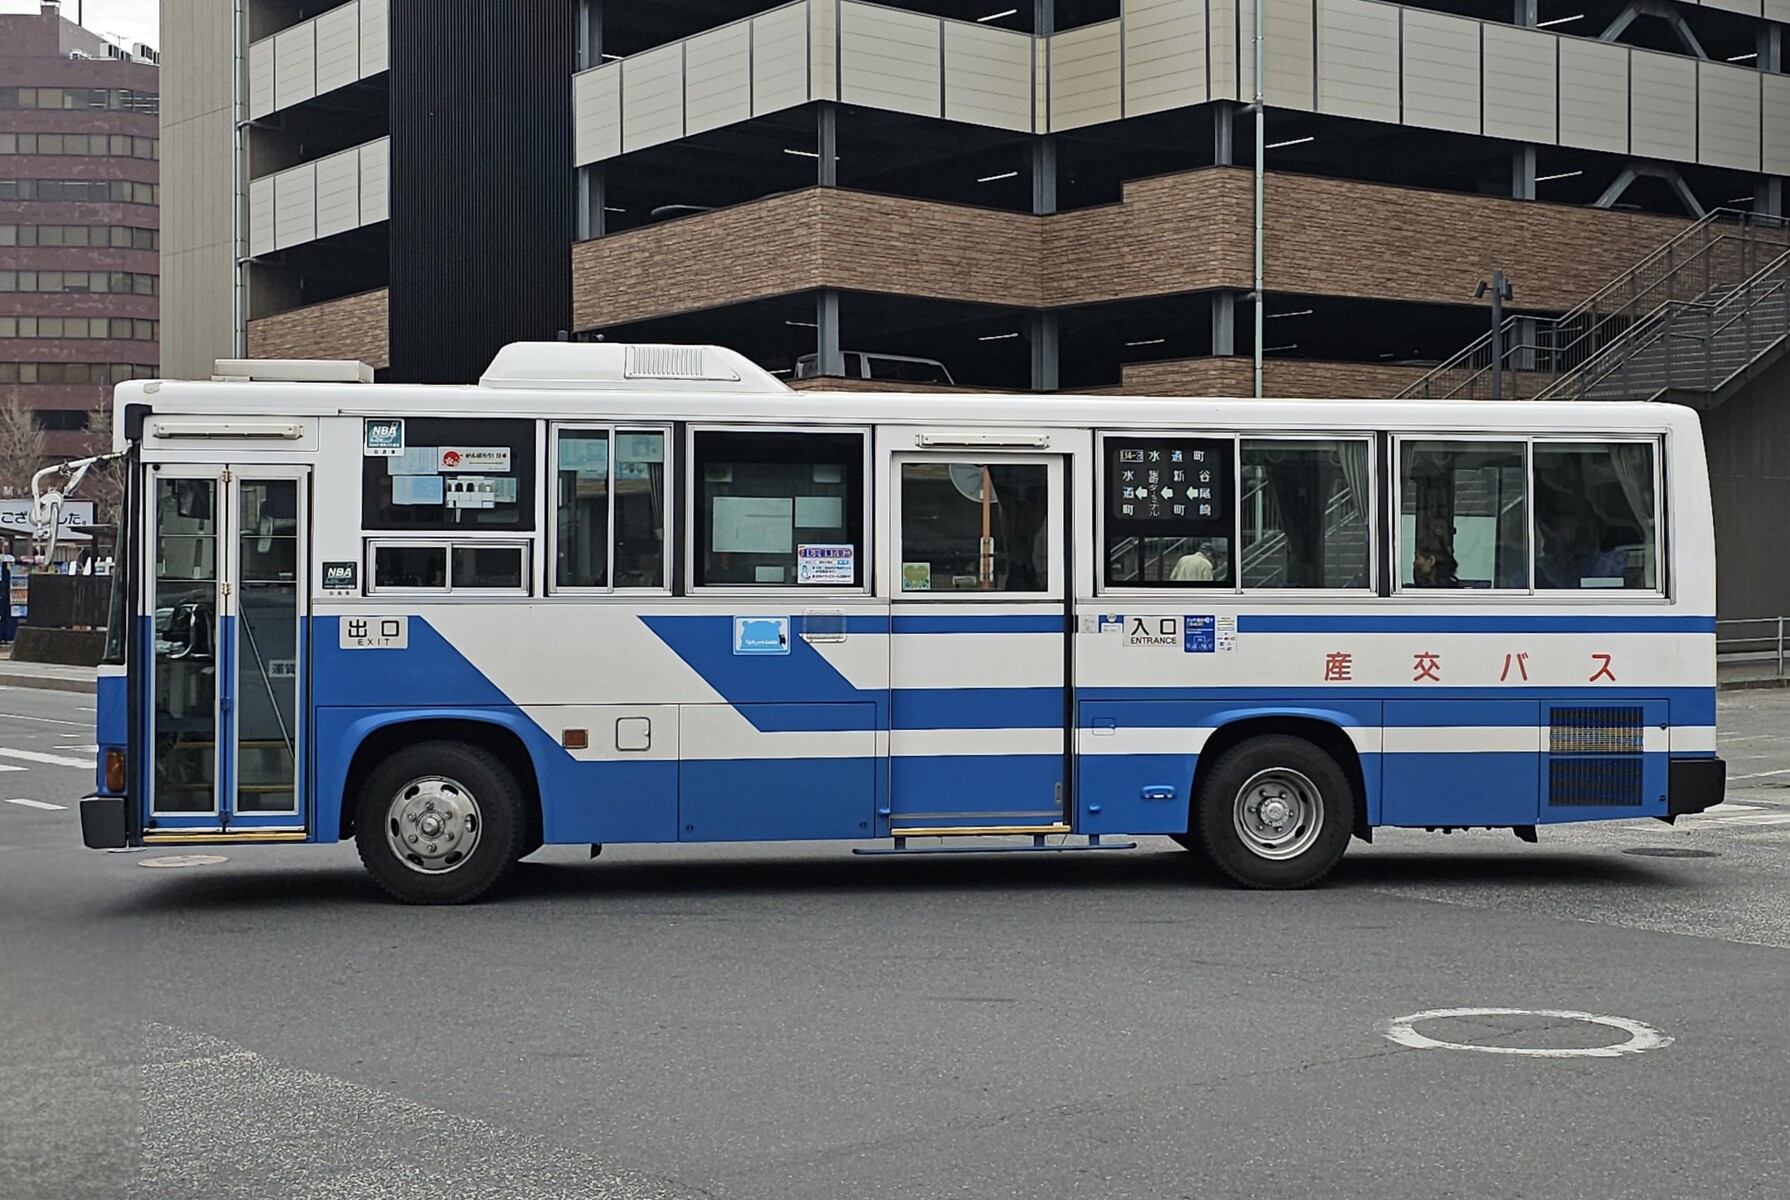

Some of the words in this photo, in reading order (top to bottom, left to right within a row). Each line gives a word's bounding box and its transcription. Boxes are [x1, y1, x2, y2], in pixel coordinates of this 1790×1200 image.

[373, 425, 397, 437] NBA
[327, 567, 352, 578] NBA
[348, 619, 400, 638] 出口
[1131, 618, 1176, 636] 入口
[357, 638, 390, 646] EXIT
[1130, 637, 1177, 645] ENTRANCE
[1324, 651, 1616, 682] 産交バス
